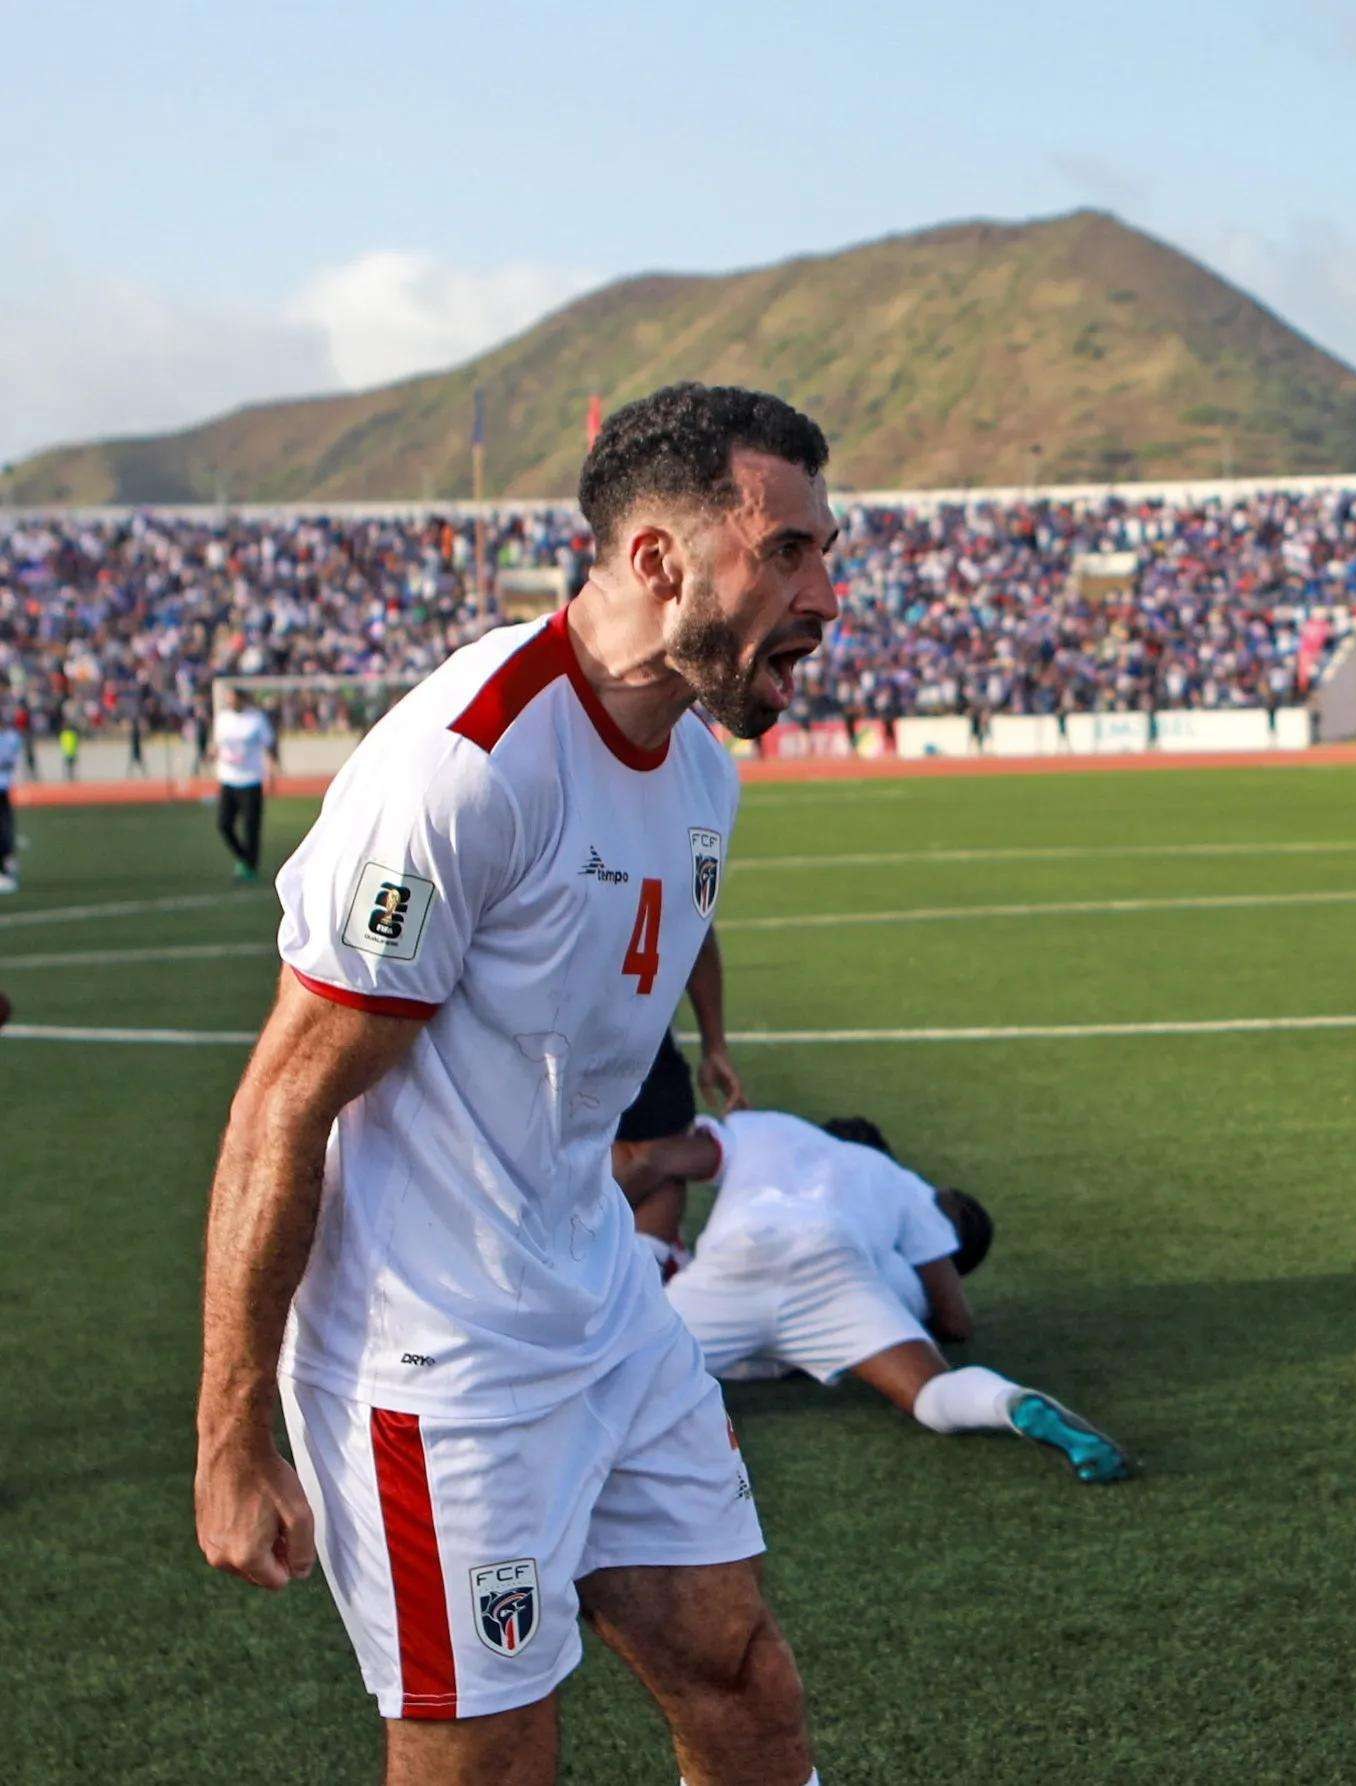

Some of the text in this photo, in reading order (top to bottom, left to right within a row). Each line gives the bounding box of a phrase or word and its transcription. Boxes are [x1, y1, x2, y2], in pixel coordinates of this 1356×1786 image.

[692, 833, 717, 847] FCF
[598, 869, 629, 885] tempo
[621, 877, 662, 995] 4
[477, 1565, 530, 1586] FCF
